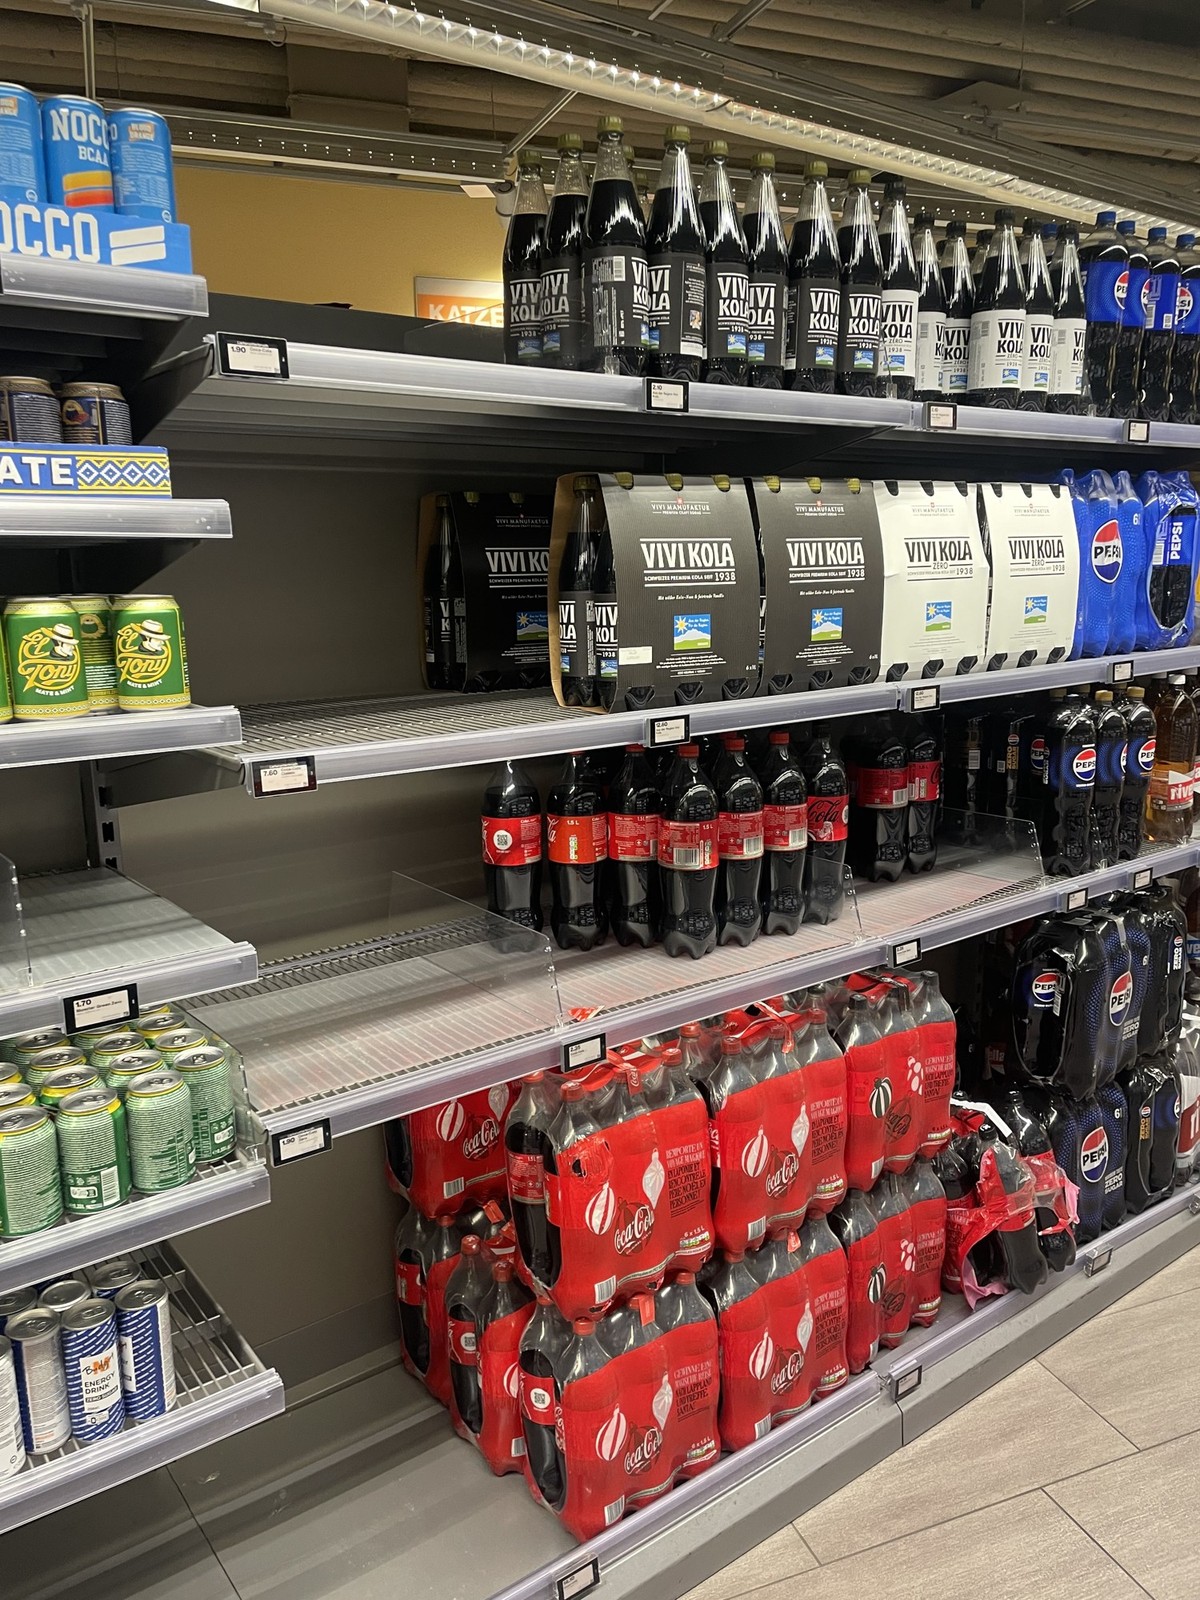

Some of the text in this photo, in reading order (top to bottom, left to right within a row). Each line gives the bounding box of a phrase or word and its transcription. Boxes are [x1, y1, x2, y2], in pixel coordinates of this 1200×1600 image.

[750, 287, 775, 309] IVI
[810, 292, 840, 312] VIVI
[849, 297, 880, 318] VIVI
[750, 308, 775, 326] OLA
[881, 304, 913, 323] VIVI
[848, 318, 880, 335] KOLA
[1008, 539, 1065, 560] VIVI KOLA
[1170, 521, 1184, 560] PEPSI
[640, 542, 735, 569] VIVI KOLA
[786, 541, 865, 566] VIVI KOLA
[904, 540, 973, 563] VIVI KOLA
[485, 551, 527, 573] VIVI
[956, 567, 974, 576] 1938
[714, 572, 736, 582] 1938
[847, 569, 865, 577] 1938
[559, 604, 575, 624] IVI
[559, 625, 577, 640] OLA
[18, 658, 79, 693] Tony
[116, 653, 167, 683] Tony
[75, 999, 92, 1008] 1.70
[1104, 1172, 1123, 1188] ZERO
[1104, 1180, 1123, 1195] SUGAR
[84, 1371, 116, 1388] ENERGY
[85, 1382, 110, 1395] DRINK
